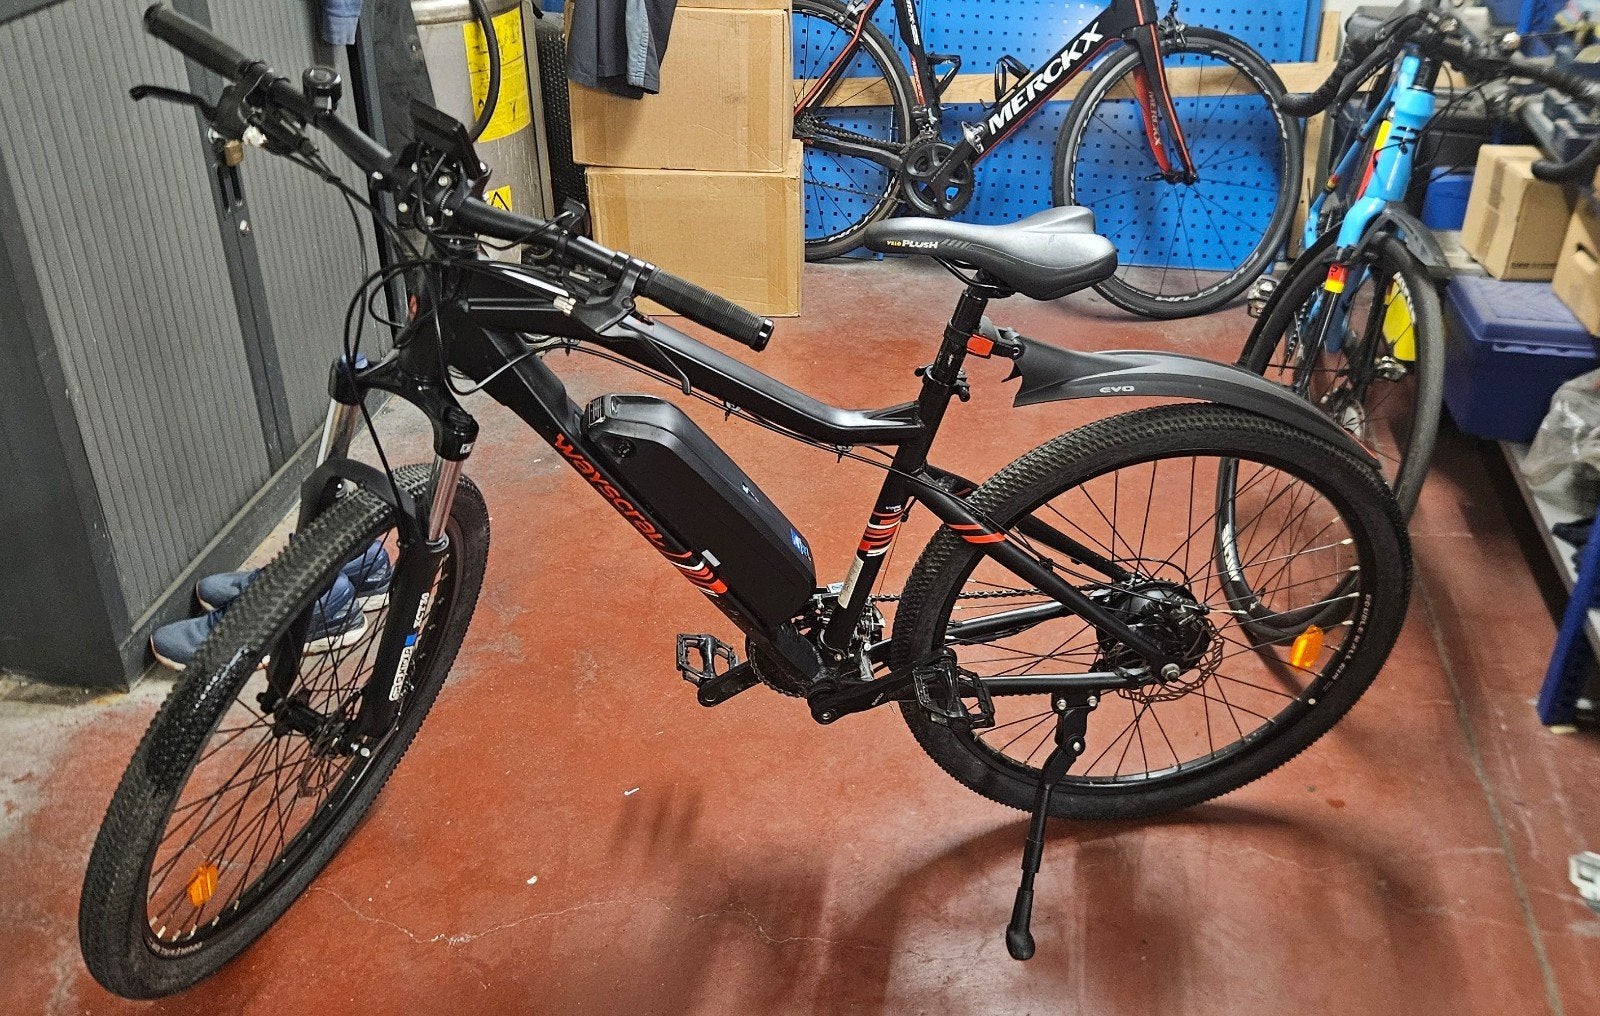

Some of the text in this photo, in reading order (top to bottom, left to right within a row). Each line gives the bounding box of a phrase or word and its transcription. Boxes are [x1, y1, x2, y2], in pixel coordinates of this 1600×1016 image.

[987, 21, 1104, 135] MERCKX
[886, 239, 939, 249] VELO PLUSH
[1099, 385, 1135, 394] EVO
[1357, 593, 1371, 634] DOUBLE
[1344, 634, 1361, 661] WALL
